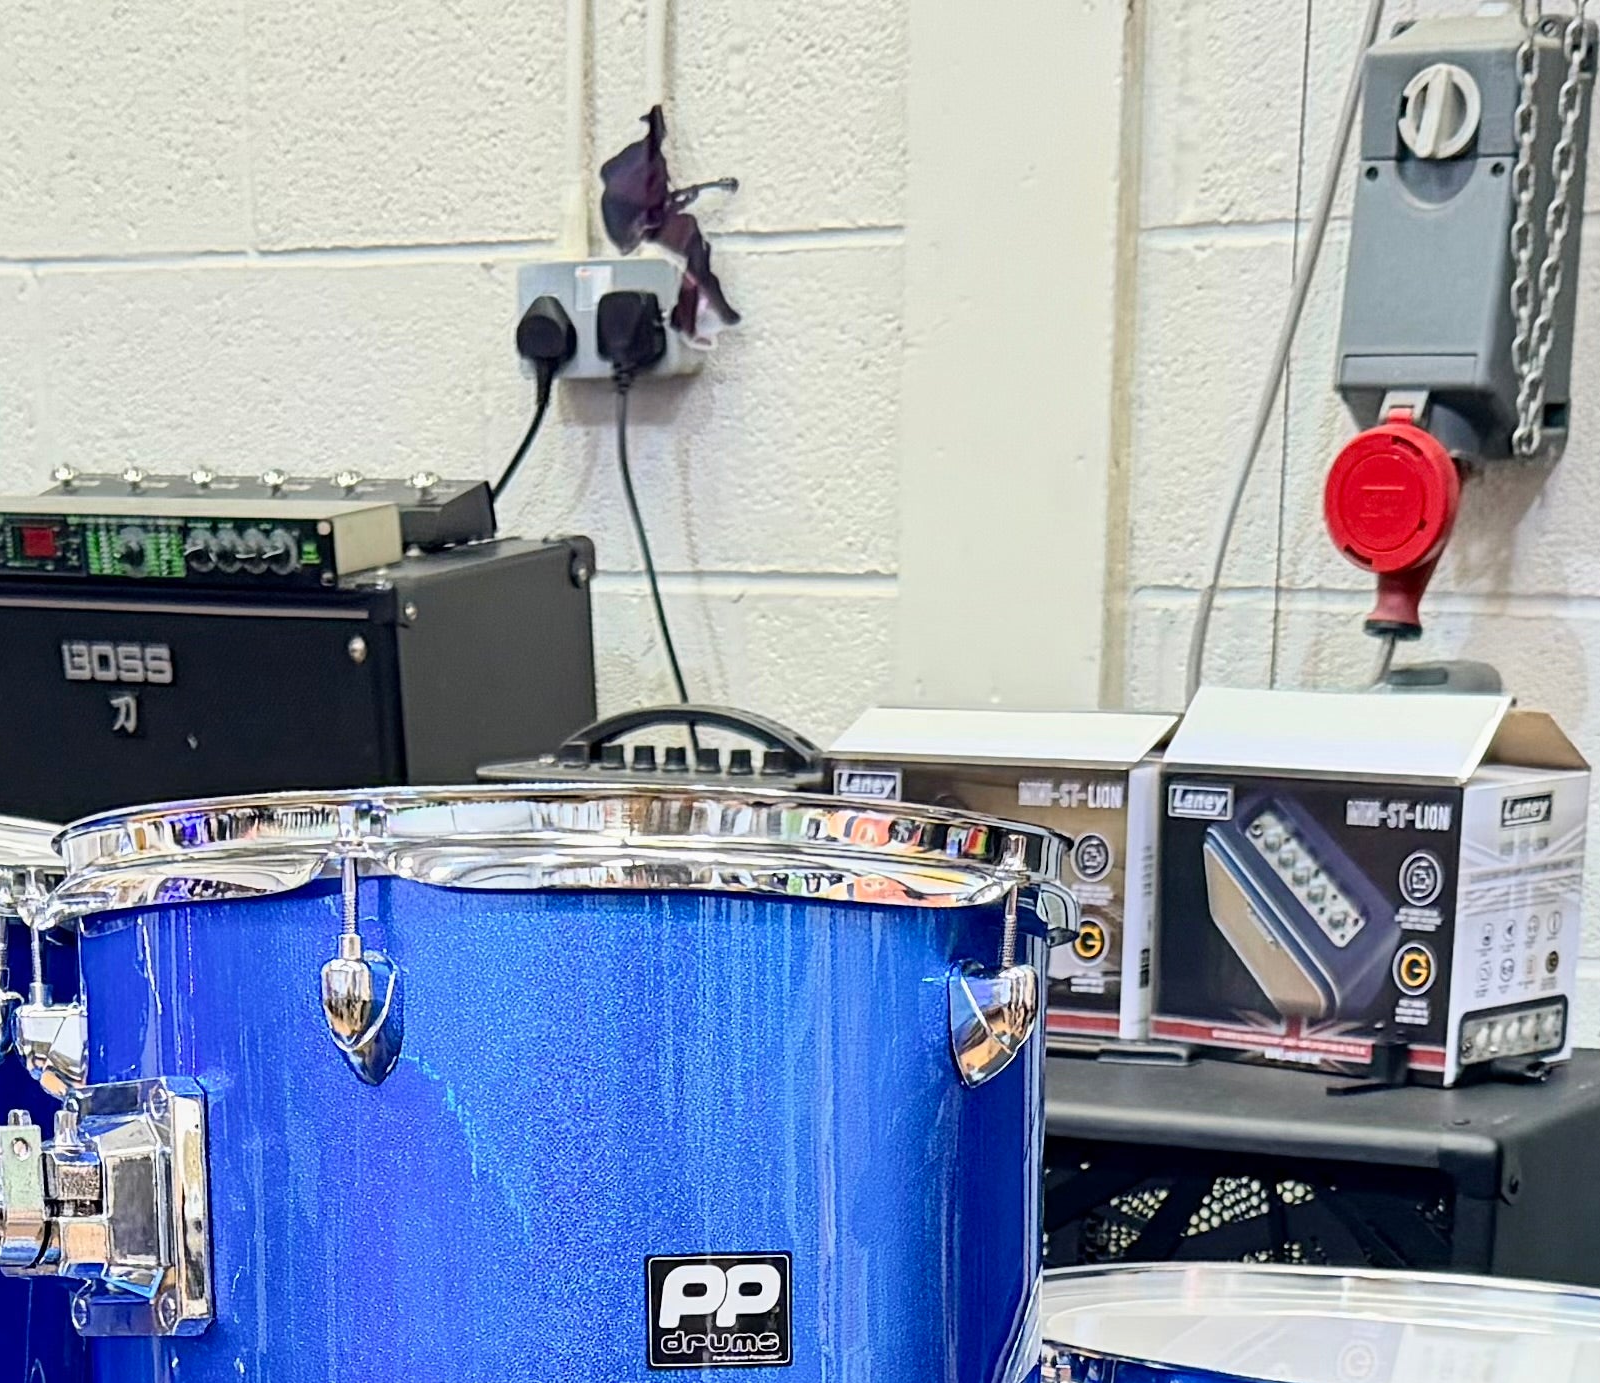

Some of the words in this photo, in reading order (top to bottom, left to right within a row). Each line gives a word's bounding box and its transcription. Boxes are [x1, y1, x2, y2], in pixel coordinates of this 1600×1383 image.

[60, 639, 173, 684] BOSS
[839, 772, 896, 798] Laney
[1173, 788, 1227, 815] Laney
[1503, 799, 1550, 826] Laney
[660, 1331, 780, 1355] drums
